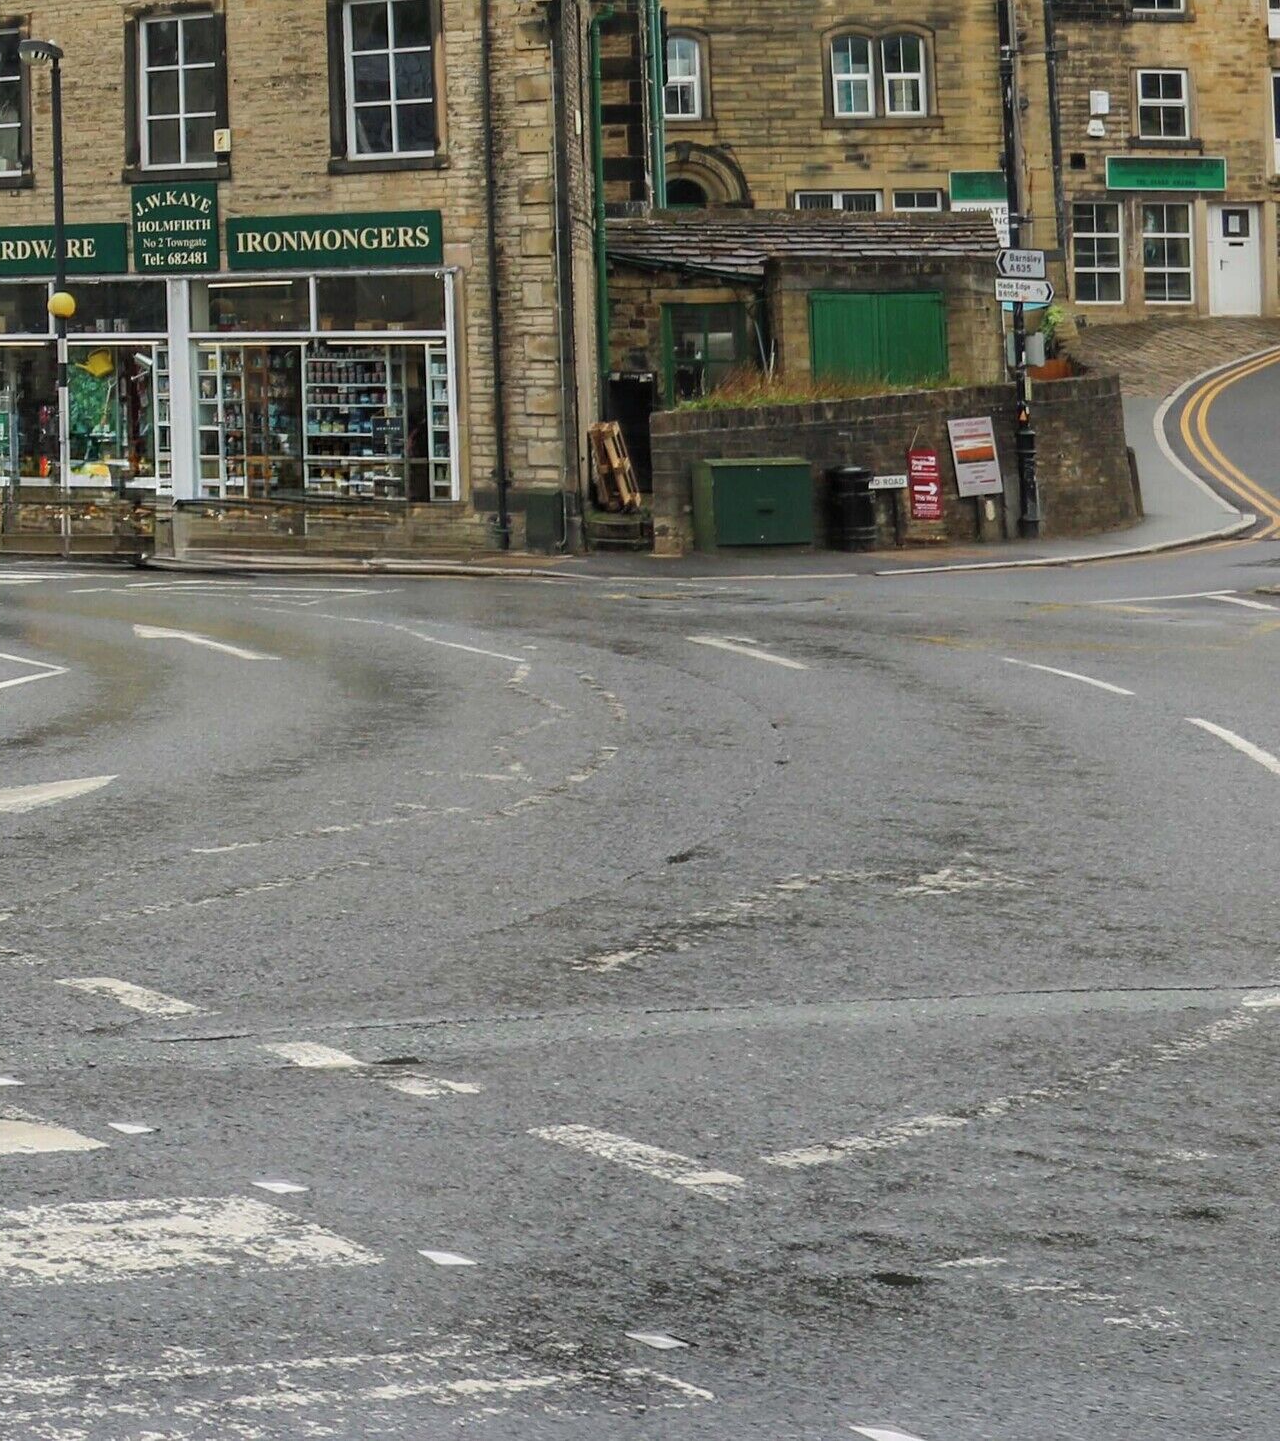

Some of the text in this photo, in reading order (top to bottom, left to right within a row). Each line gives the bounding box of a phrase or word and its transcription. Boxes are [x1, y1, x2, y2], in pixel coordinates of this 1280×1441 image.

[137, 219, 212, 232] HOLMFIRTH
[143, 237, 207, 250] No 2 Towngate
[236, 225, 430, 253] IRONMONGERS
[142, 251, 208, 265] Tel: 682481
[1010, 252, 1041, 264] Barnsley
[1015, 282, 1031, 291] Edge
[882, 477, 905, 486] ROAD
